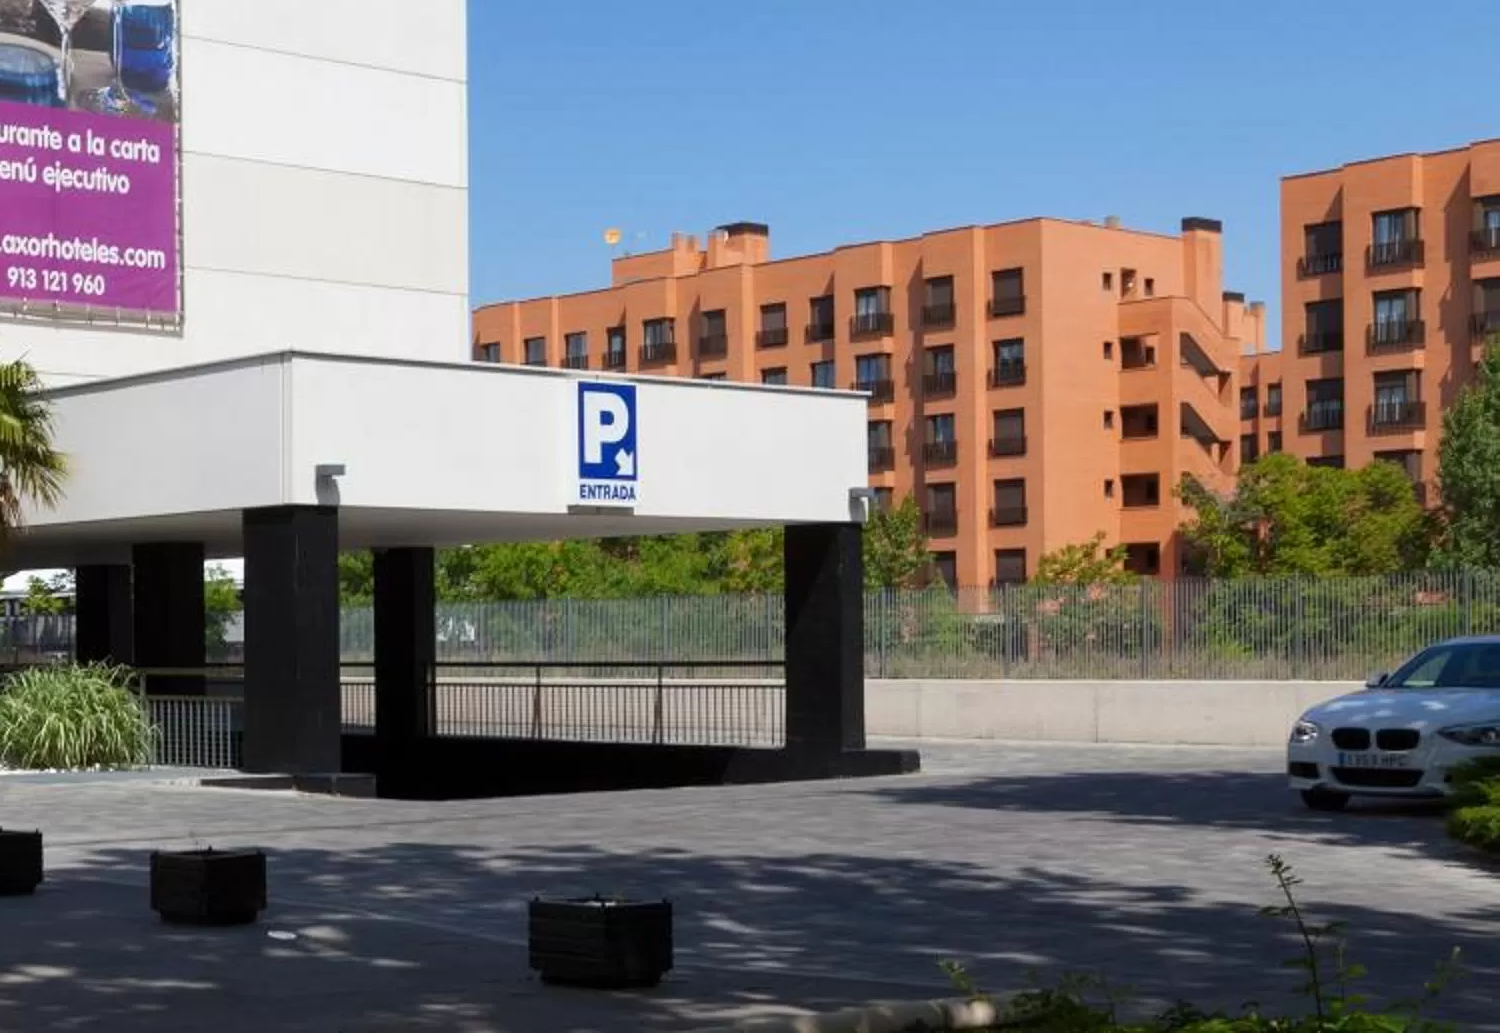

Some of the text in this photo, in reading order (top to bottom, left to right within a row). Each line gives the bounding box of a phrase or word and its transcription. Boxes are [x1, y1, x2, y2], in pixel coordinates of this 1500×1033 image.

[67, 136, 81, 154] a
[87, 129, 104, 156] la
[110, 139, 160, 162] carta
[42, 162, 130, 194] ejecutivo
[7, 267, 106, 296] 913 121 960
[583, 391, 629, 464] P
[579, 484, 637, 501] ENTRADA
